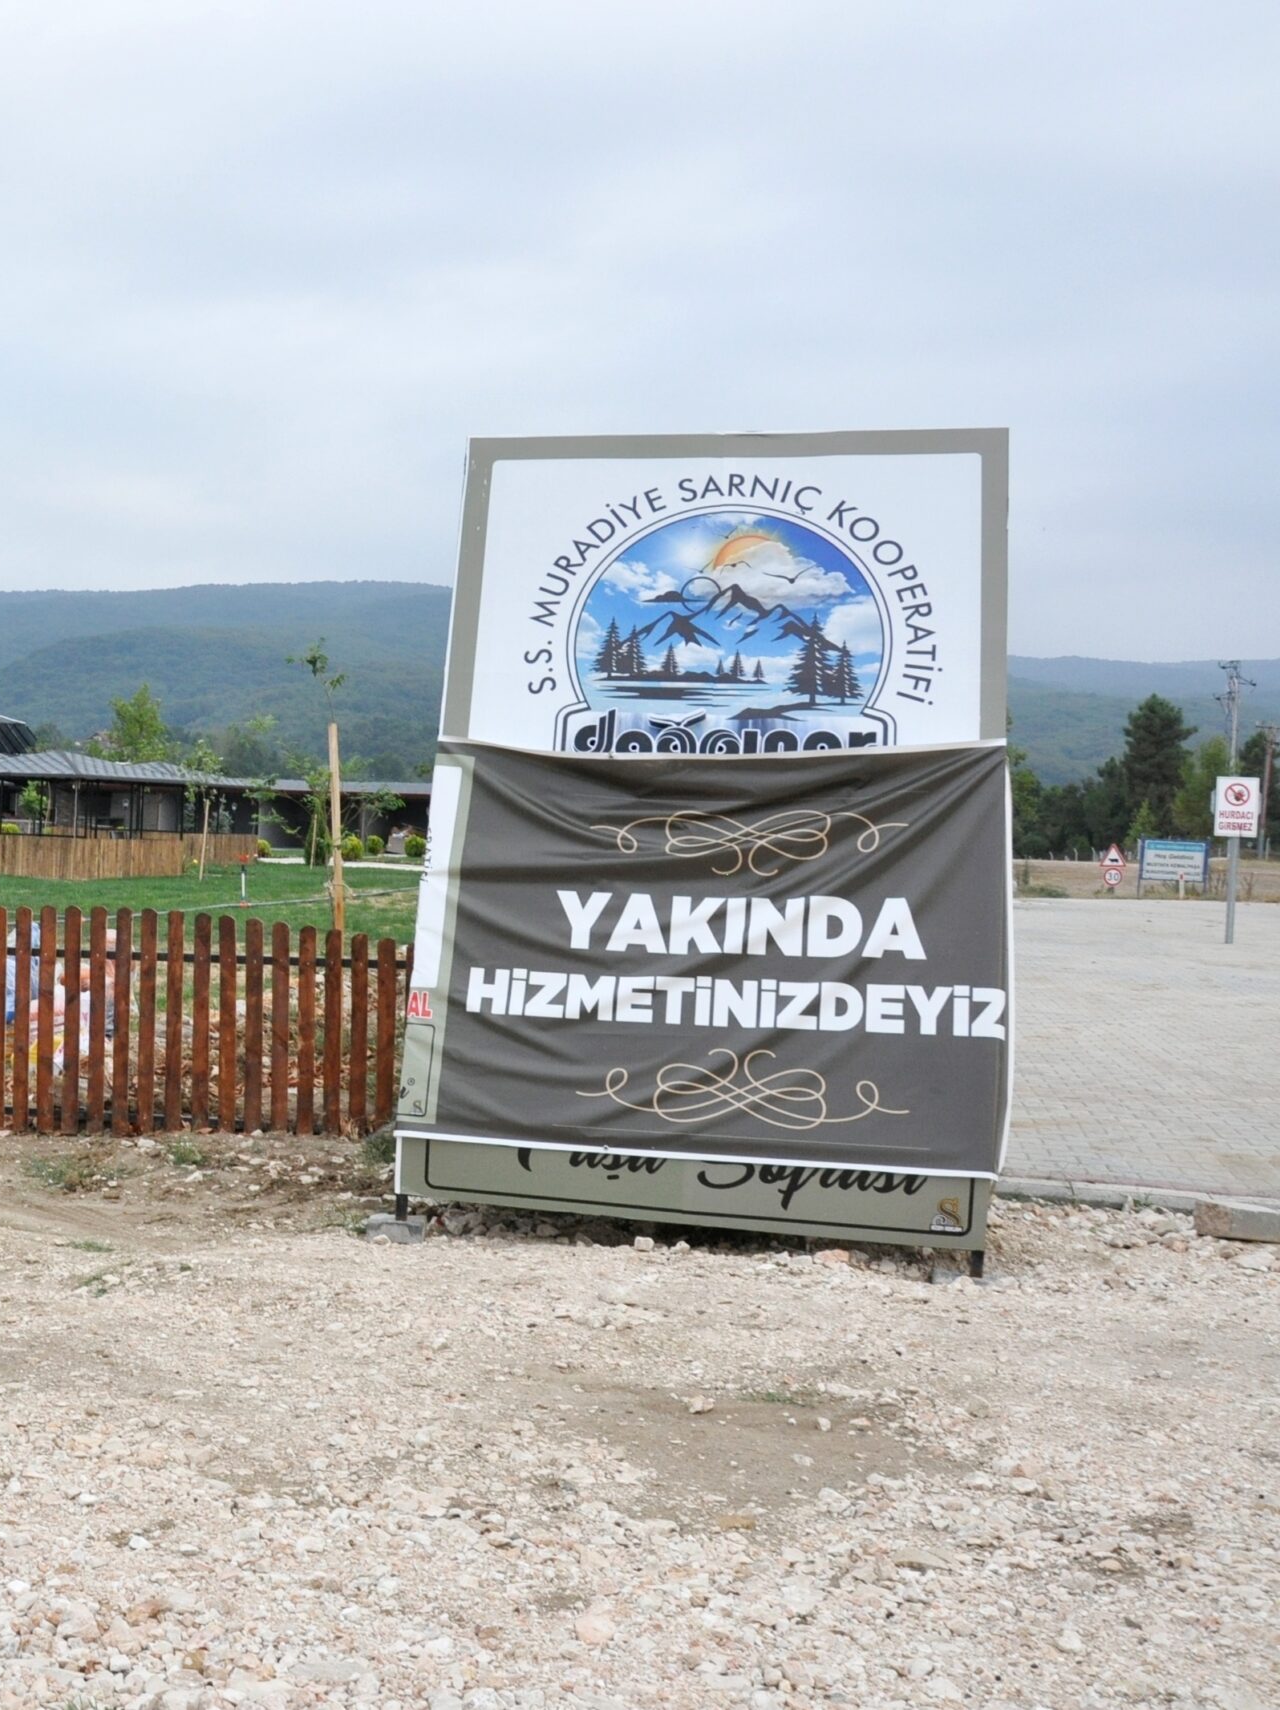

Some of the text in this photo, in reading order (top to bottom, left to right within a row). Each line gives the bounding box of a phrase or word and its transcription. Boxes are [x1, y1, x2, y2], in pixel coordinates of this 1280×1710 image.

[524, 473, 944, 705] S.S. MURADİYE SARNIÇ KOOPERATİFİ
[1107, 872, 1120, 881] 30
[556, 890, 927, 960] YAKINDA
